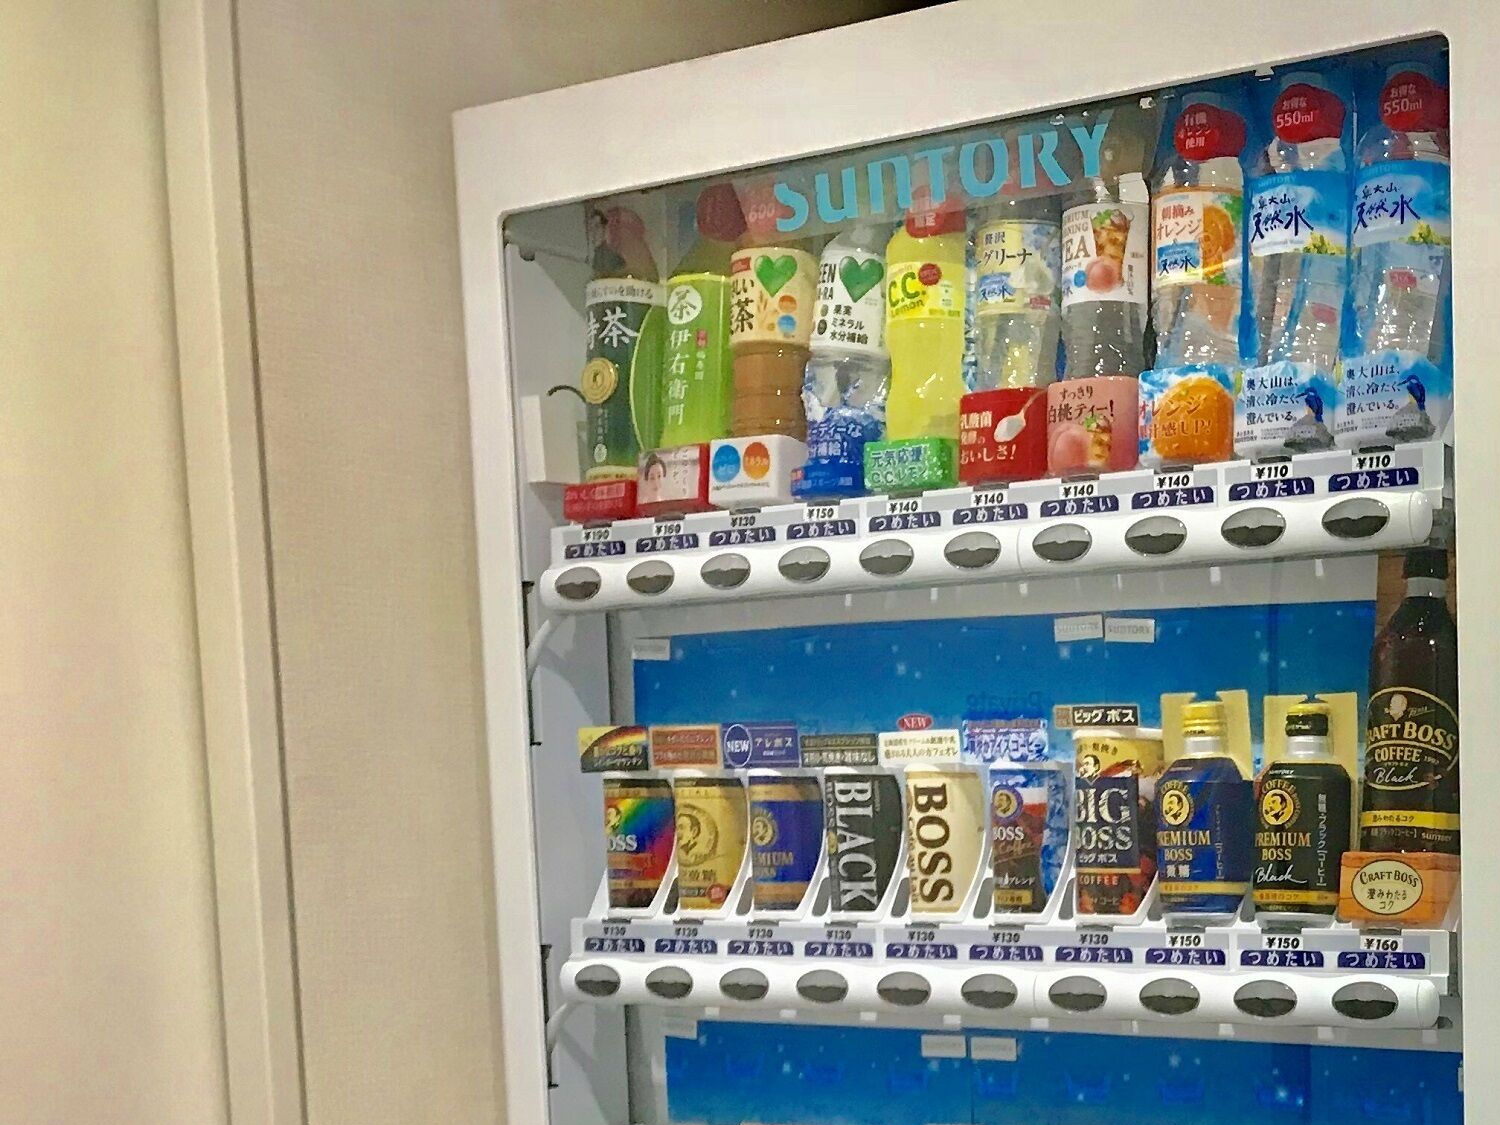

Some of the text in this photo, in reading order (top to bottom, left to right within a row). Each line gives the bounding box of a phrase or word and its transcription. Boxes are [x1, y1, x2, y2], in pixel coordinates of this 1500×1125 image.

[1383, 98, 1422, 116] 550ml
[1276, 110, 1313, 128] 550ml
[773, 121, 1109, 232] SUNTORY
[1353, 194, 1420, 234] 天然水
[1250, 205, 1314, 242] 天然水
[831, 316, 865, 330] ミネラル
[668, 329, 692, 426] 伊右衛門
[1059, 385, 1093, 401] すっきり
[1356, 455, 1391, 470] ¥110
[1256, 465, 1289, 480] ¥110
[1336, 469, 1410, 488] つめたい
[1157, 475, 1190, 488] ¥140
[1237, 479, 1307, 498] つめたい
[974, 492, 1004, 505] ¥140
[1063, 484, 1094, 498] ¥140
[1140, 487, 1205, 507] つめたい
[807, 508, 834, 519] ¥150
[889, 501, 918, 513] ¥140
[1048, 496, 1112, 515] つめたい
[874, 512, 935, 530] つめたい
[960, 505, 1021, 523] つめたい
[715, 527, 771, 545] つめたい
[793, 520, 850, 536] つめたい
[570, 542, 621, 557] つめたい
[641, 534, 694, 551] つめたい
[903, 716, 928, 729] NEW
[1074, 707, 1136, 724] ビッグ ボス
[1402, 721, 1457, 751] BOSS
[727, 739, 750, 753] NEW
[1374, 746, 1422, 763] COFFEE
[1373, 766, 1419, 785] Black
[834, 781, 879, 907] BLACK
[913, 783, 954, 903] BOSS
[1163, 849, 1193, 861] BOSS
[1261, 849, 1293, 861] BOSS
[1255, 863, 1308, 884] Black
[1359, 869, 1419, 888] CRAFT BOSS
[1379, 900, 1395, 911] コク
[908, 931, 935, 942] ¥130
[993, 932, 1021, 943] ¥130
[1079, 933, 1109, 945] ¥130
[1169, 935, 1202, 947] ¥150
[1266, 937, 1300, 949] ¥150
[1364, 938, 1398, 951] ¥160
[975, 946, 1037, 961] つめたい
[1062, 947, 1126, 963] つめたい
[1153, 949, 1218, 965] つめたい
[1248, 951, 1317, 967] つめたい
[1345, 952, 1417, 969] つめたい
